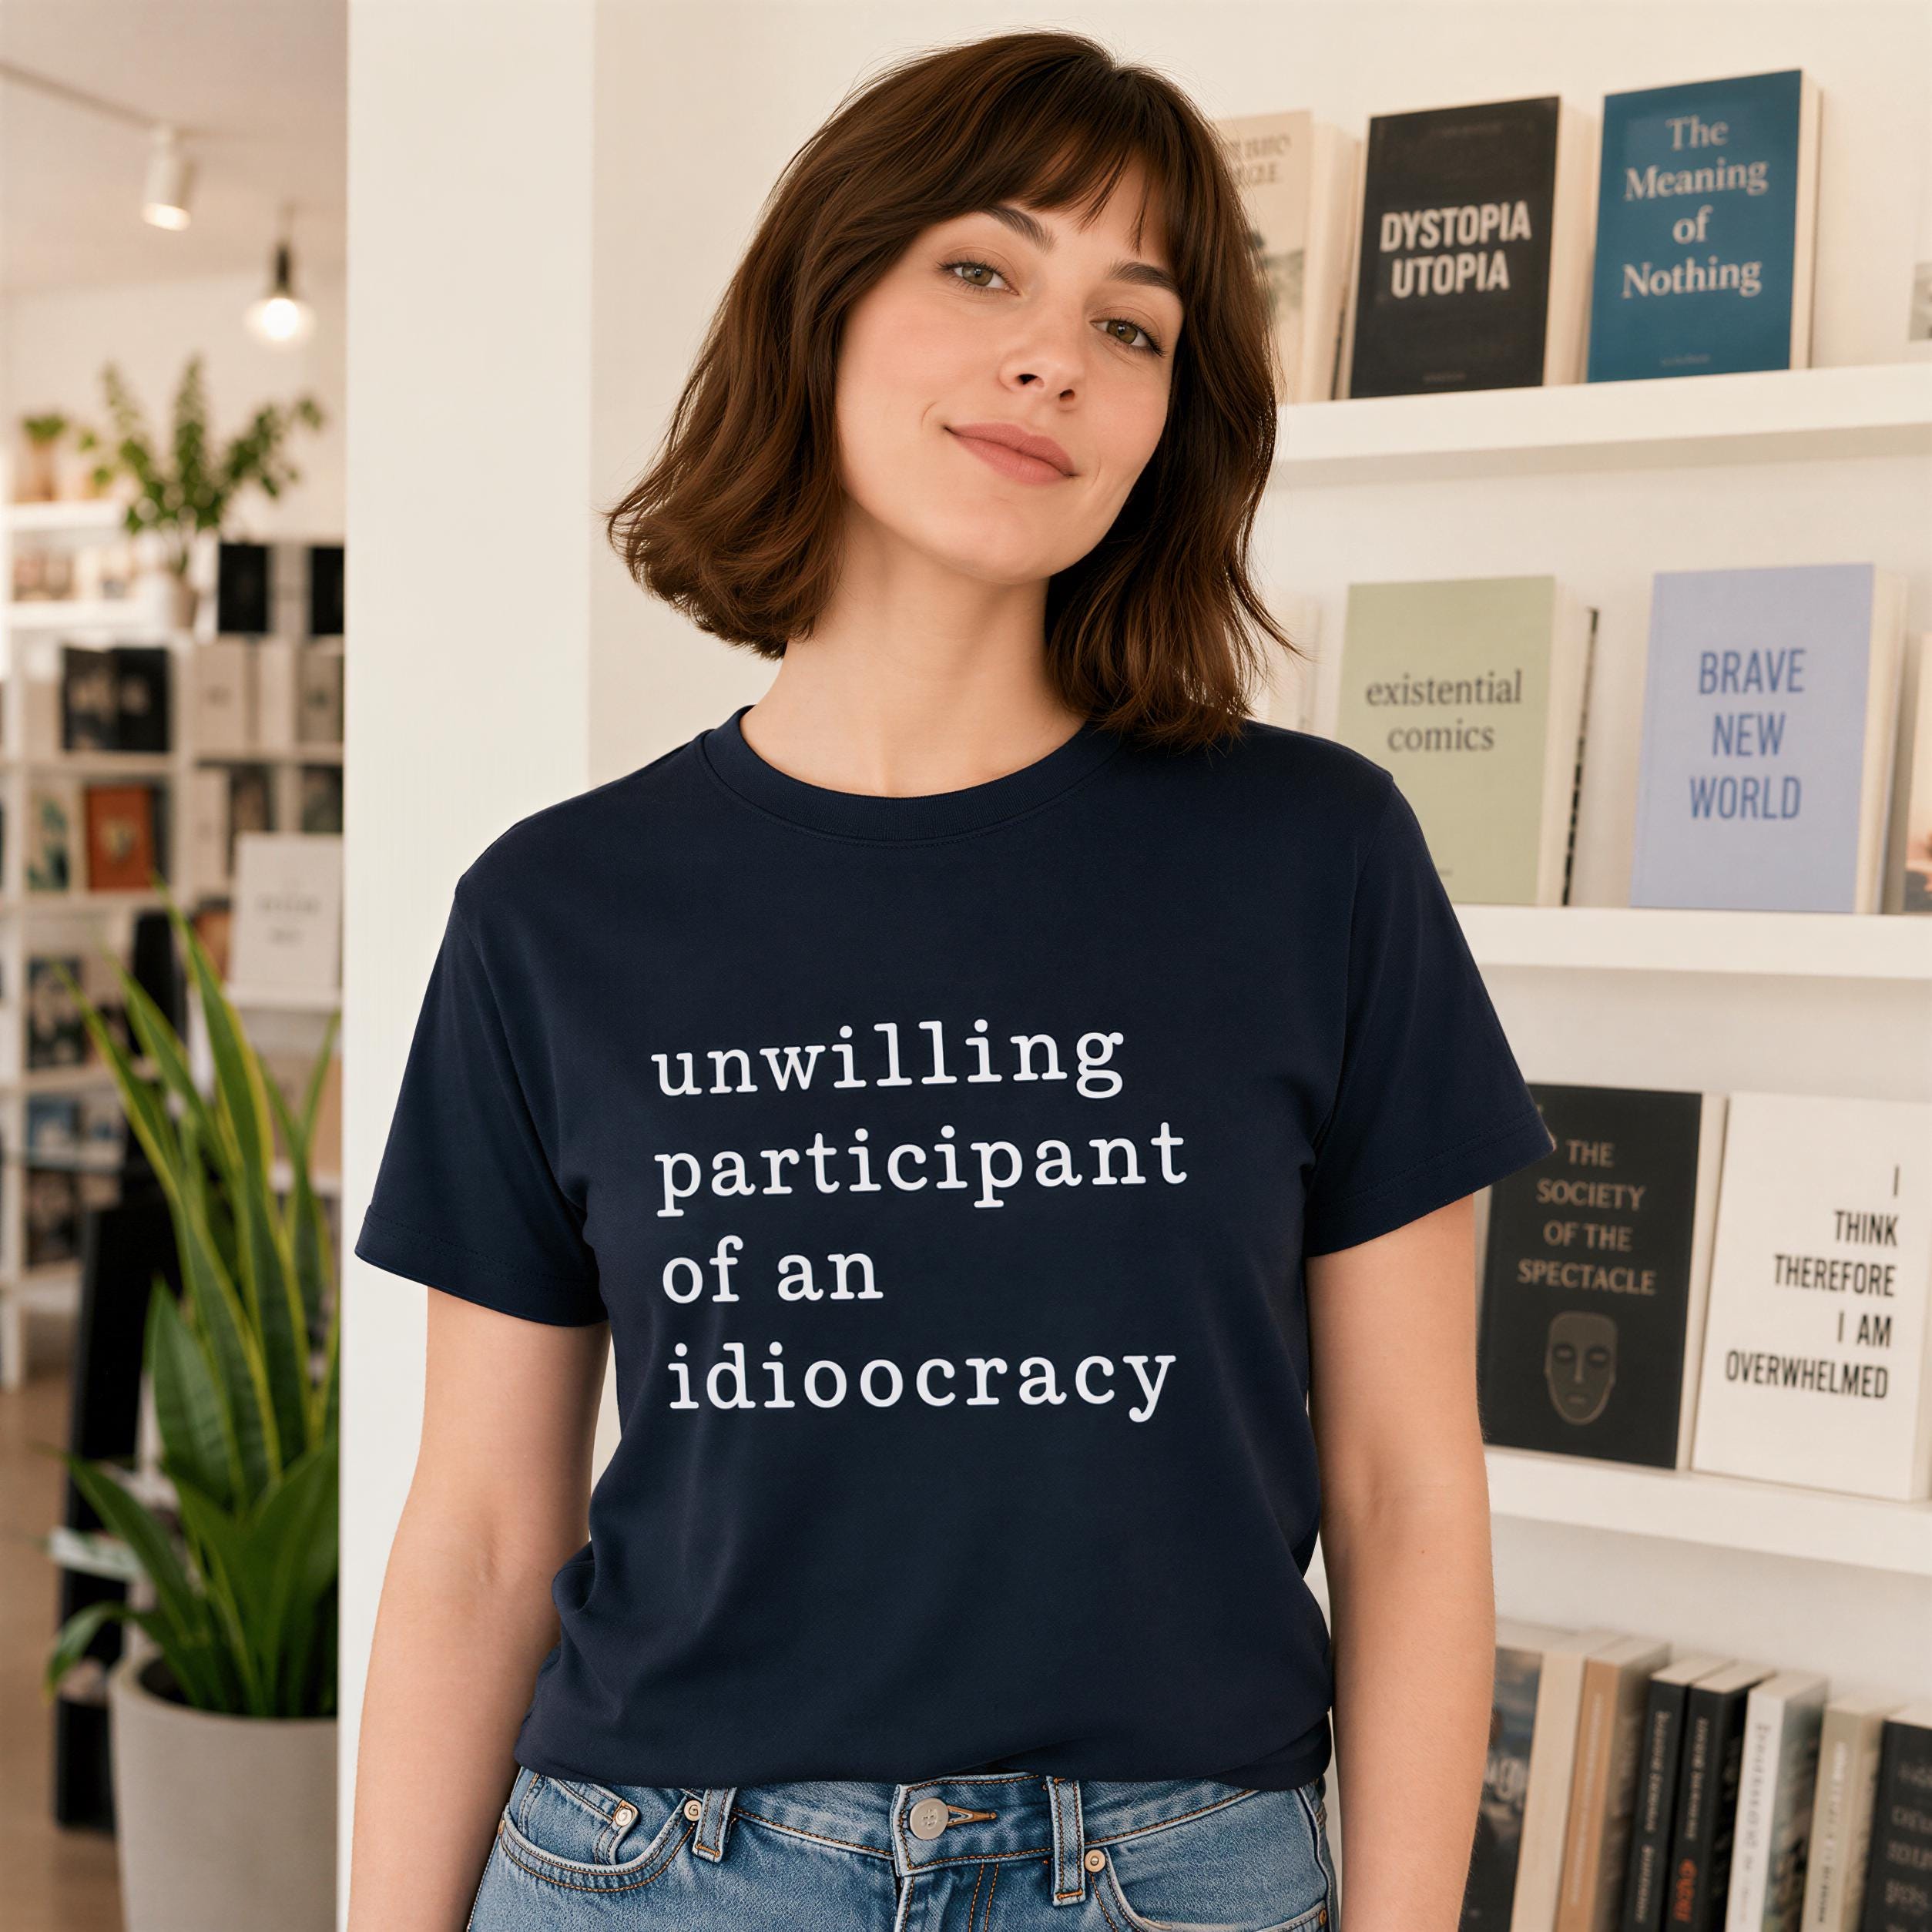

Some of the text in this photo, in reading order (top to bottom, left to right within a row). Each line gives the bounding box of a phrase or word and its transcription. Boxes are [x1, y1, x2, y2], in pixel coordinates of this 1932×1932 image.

[1667, 116, 1728, 149] The
[1625, 158, 1768, 201] Meaning
[1380, 200, 1531, 253] DYSTOPIA
[1673, 205, 1712, 243] of
[1390, 249, 1509, 299] UTOPIA
[1623, 256, 1762, 299] Nothing
[1366, 669, 1522, 706] existential
[1699, 648, 1806, 695] BRAVE
[1387, 719, 1494, 752] comics
[1712, 713, 1786, 756] NEW
[1689, 776, 1802, 820] WORLD
[650, 1018, 1124, 1099] unwilling
[654, 1122, 1188, 1217] participant
[1567, 1139, 1612, 1167] THE
[1537, 1179, 1645, 1210] SOCIETY
[1892, 1166, 1901, 1197] I
[1543, 1221, 1630, 1252] OF THE
[1834, 1210, 1898, 1246] THINK
[662, 1235, 884, 1304] of an
[1518, 1259, 1655, 1295] SPECTACLE
[1773, 1254, 1896, 1297] THEREFORE
[1836, 1311, 1893, 1347] I AM
[667, 1341, 1176, 1423] idioocracy
[1726, 1350, 1890, 1399] OVERWHELMED
